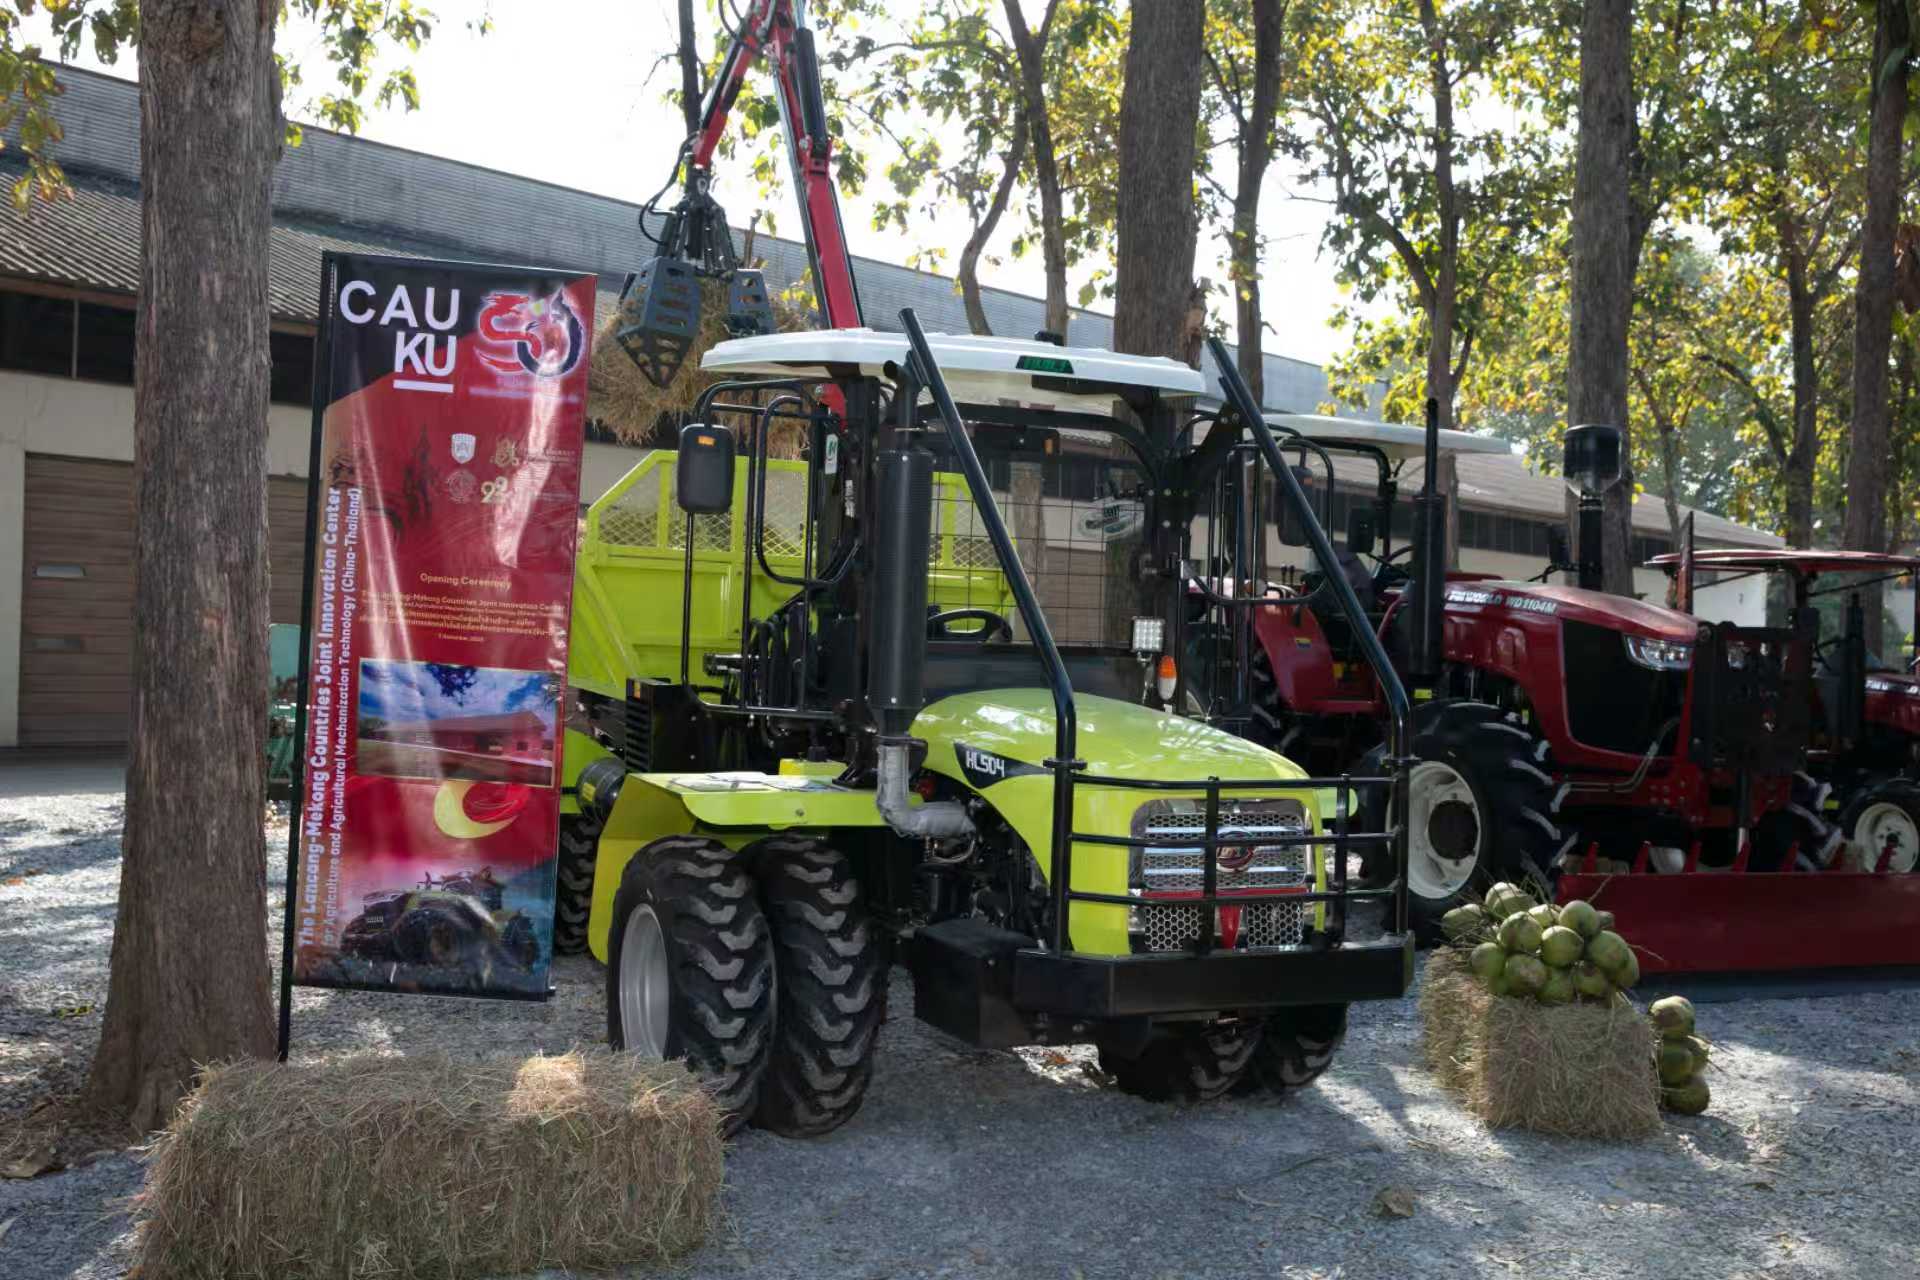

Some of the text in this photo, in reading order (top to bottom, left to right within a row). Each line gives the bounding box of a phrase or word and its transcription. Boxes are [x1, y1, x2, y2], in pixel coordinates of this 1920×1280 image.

[339, 279, 460, 331] CAU
[393, 330, 457, 377] KU
[341, 488, 362, 592] (China-Thailand)
[419, 572, 459, 586] Opening
[339, 595, 356, 664] Technology
[297, 488, 340, 946] The Lancang-Mekong Countries Joint Innovation Center
[334, 668, 349, 755] Mechanization
[330, 758, 346, 830] Agricultural
[966, 751, 1005, 778] HL504
[329, 833, 341, 855] and
[323, 858, 339, 926] Agriculture
